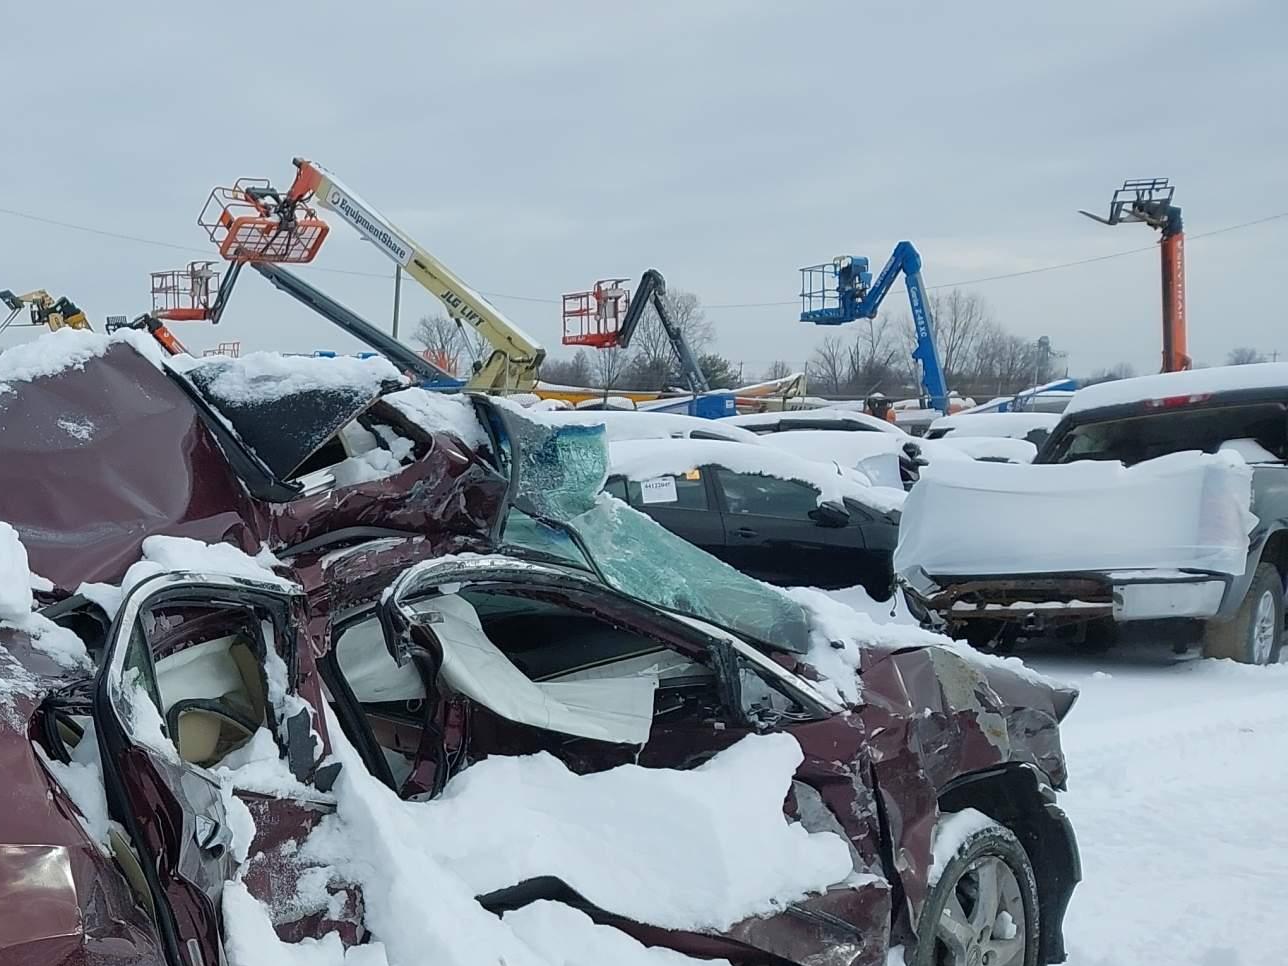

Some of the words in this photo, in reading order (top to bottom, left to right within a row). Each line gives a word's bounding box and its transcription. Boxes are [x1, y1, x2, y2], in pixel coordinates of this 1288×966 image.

[339, 198, 406, 259] EquipmentShare
[440, 290, 462, 309] JLG
[460, 305, 485, 326] LIFT
[919, 326, 928, 338] XC
